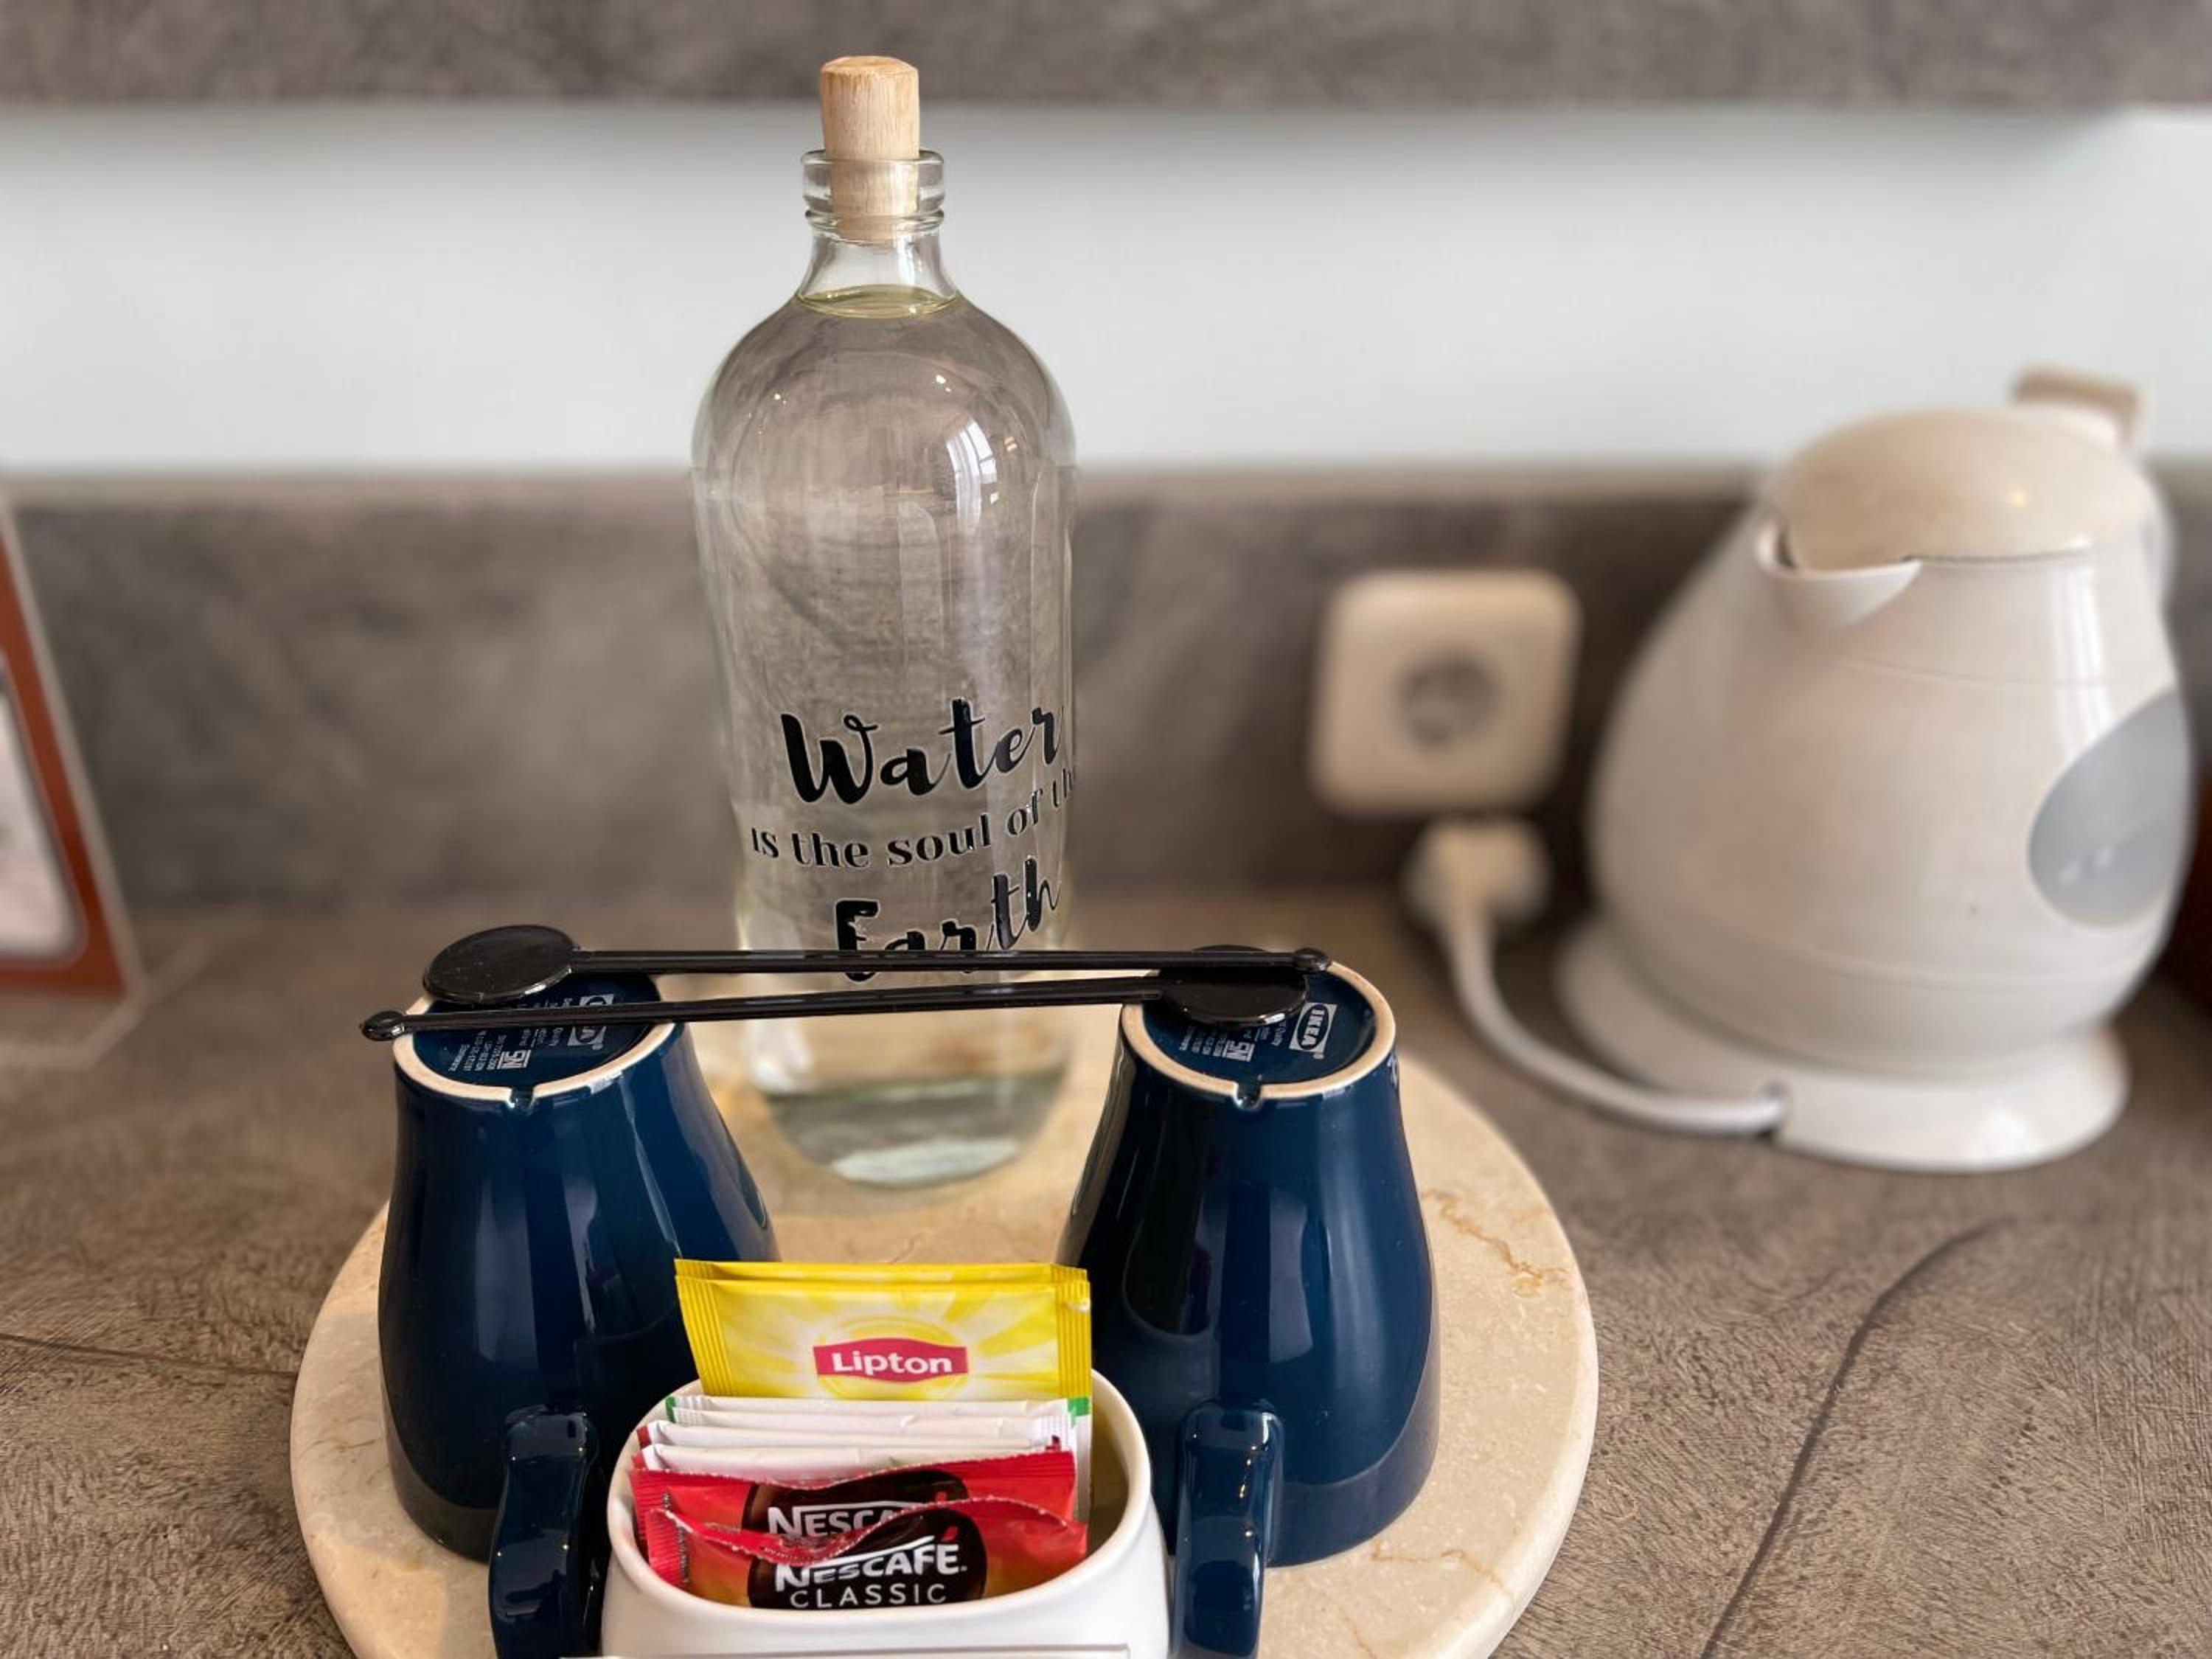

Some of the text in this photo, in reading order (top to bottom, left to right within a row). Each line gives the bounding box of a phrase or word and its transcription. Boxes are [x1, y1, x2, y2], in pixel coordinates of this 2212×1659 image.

[781, 698, 1063, 804] Water
[791, 832, 869, 868] the
[887, 814, 991, 865] soul
[1006, 787, 1043, 836] of
[1300, 1008, 1326, 1047] IKEA
[831, 1350, 953, 1376] Lipton
[790, 1583, 947, 1609] CLASSIC
